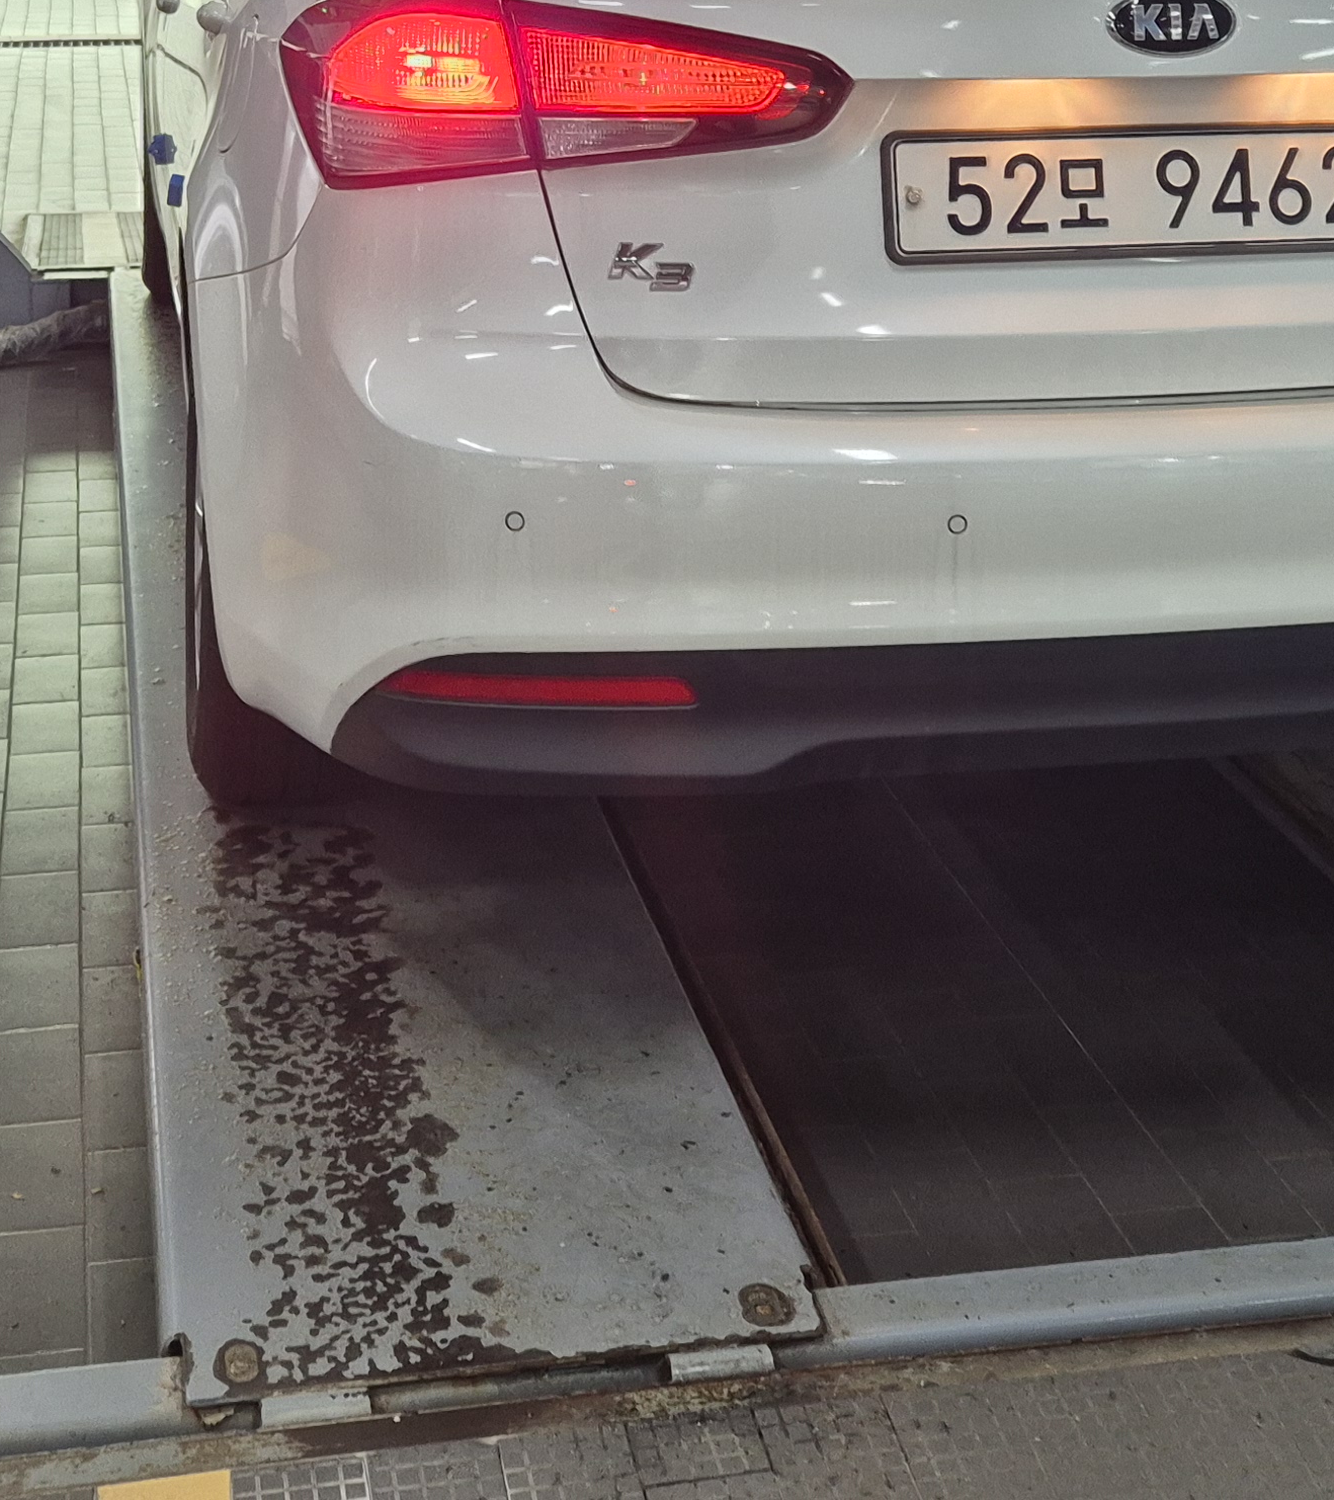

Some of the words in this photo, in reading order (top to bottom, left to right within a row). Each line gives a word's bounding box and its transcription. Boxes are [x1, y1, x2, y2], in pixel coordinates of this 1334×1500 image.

[1133, 2, 1220, 42] KIA
[946, 153, 1110, 236] 52모
[607, 241, 696, 293] K3
